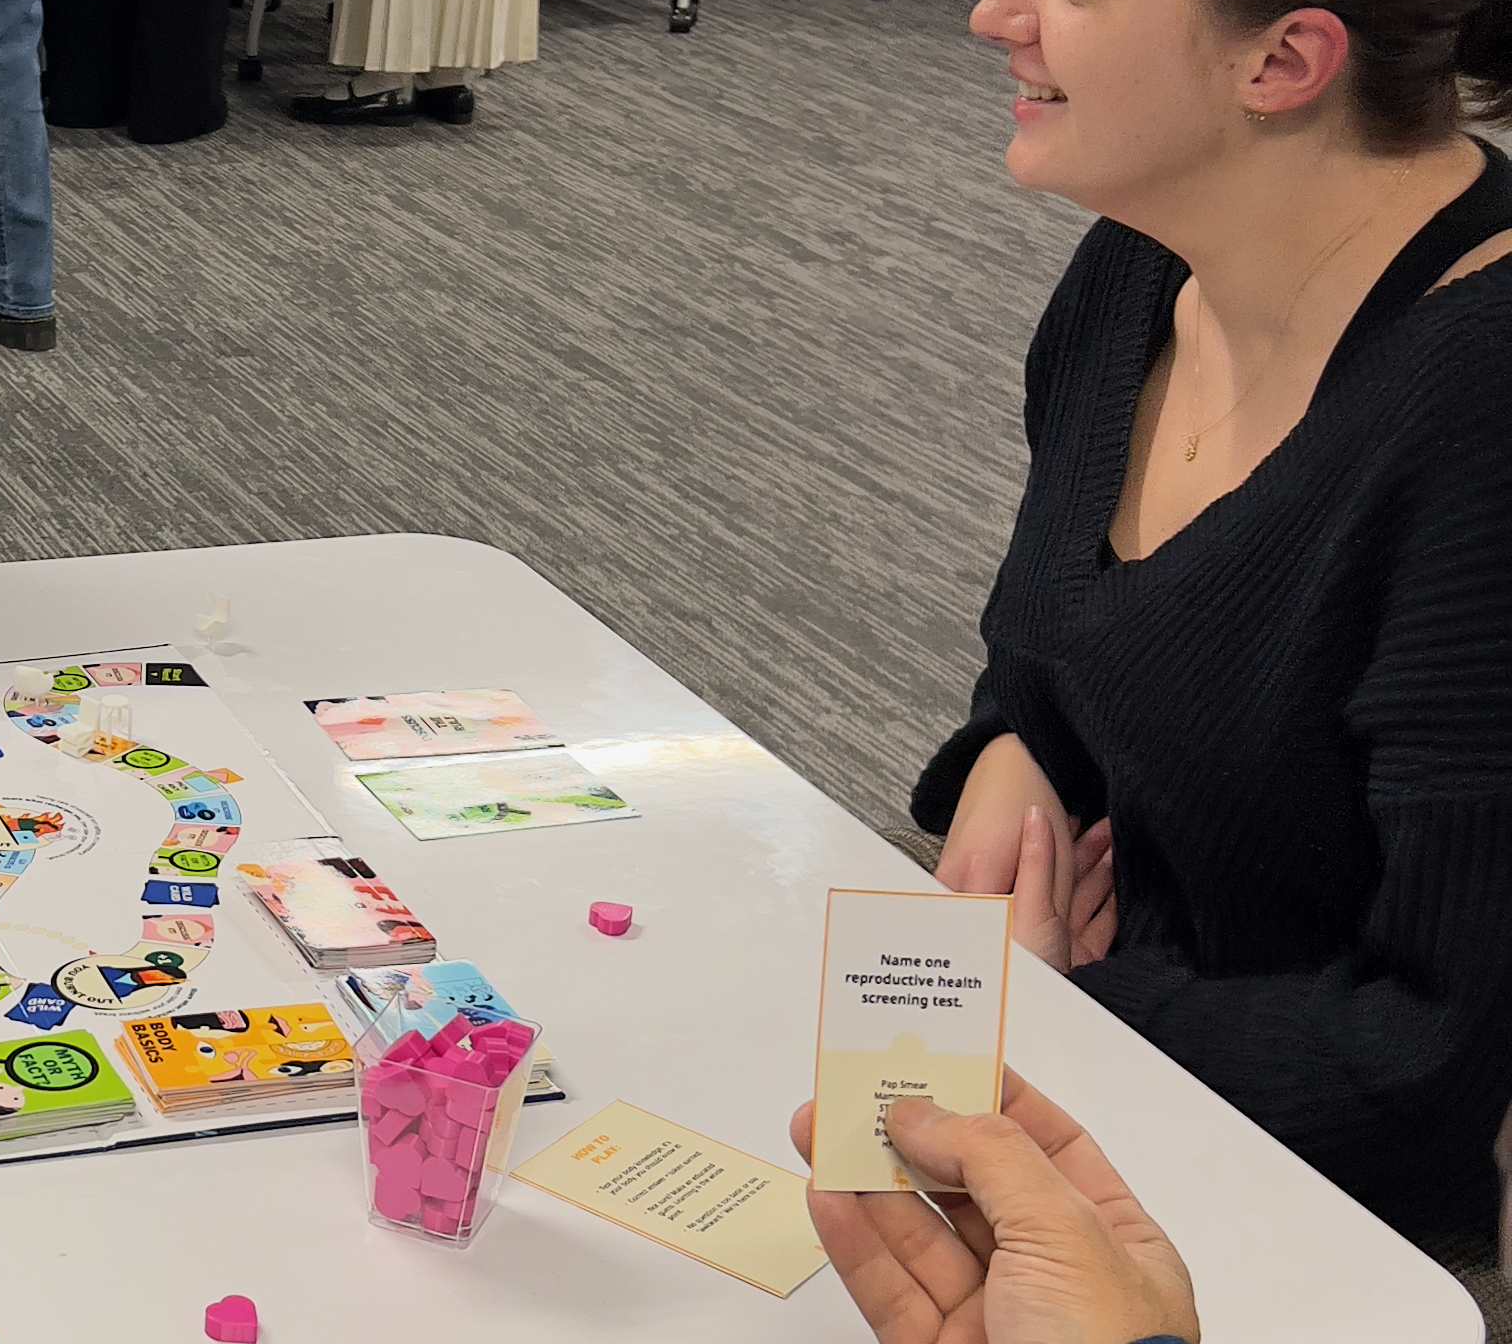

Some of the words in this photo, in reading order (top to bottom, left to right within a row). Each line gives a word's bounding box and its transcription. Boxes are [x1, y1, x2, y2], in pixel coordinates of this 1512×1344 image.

[880, 954, 921, 967] Name
[925, 957, 951, 969] one
[845, 972, 935, 989] reproductive
[937, 976, 982, 990] health
[861, 992, 928, 1009] screening
[932, 995, 963, 1008] test.
[131, 1023, 165, 1065] BASICS
[151, 1021, 177, 1053] BODY
[18, 1053, 51, 1088] FACT?
[42, 1057, 64, 1077] OR
[53, 1048, 92, 1084] MYTH
[881, 1080, 898, 1090] Pap
[900, 1080, 929, 1090] Smear
[571, 1143, 596, 1162] HOW
[593, 1134, 610, 1147] TO
[590, 1144, 622, 1165] PLAY:
